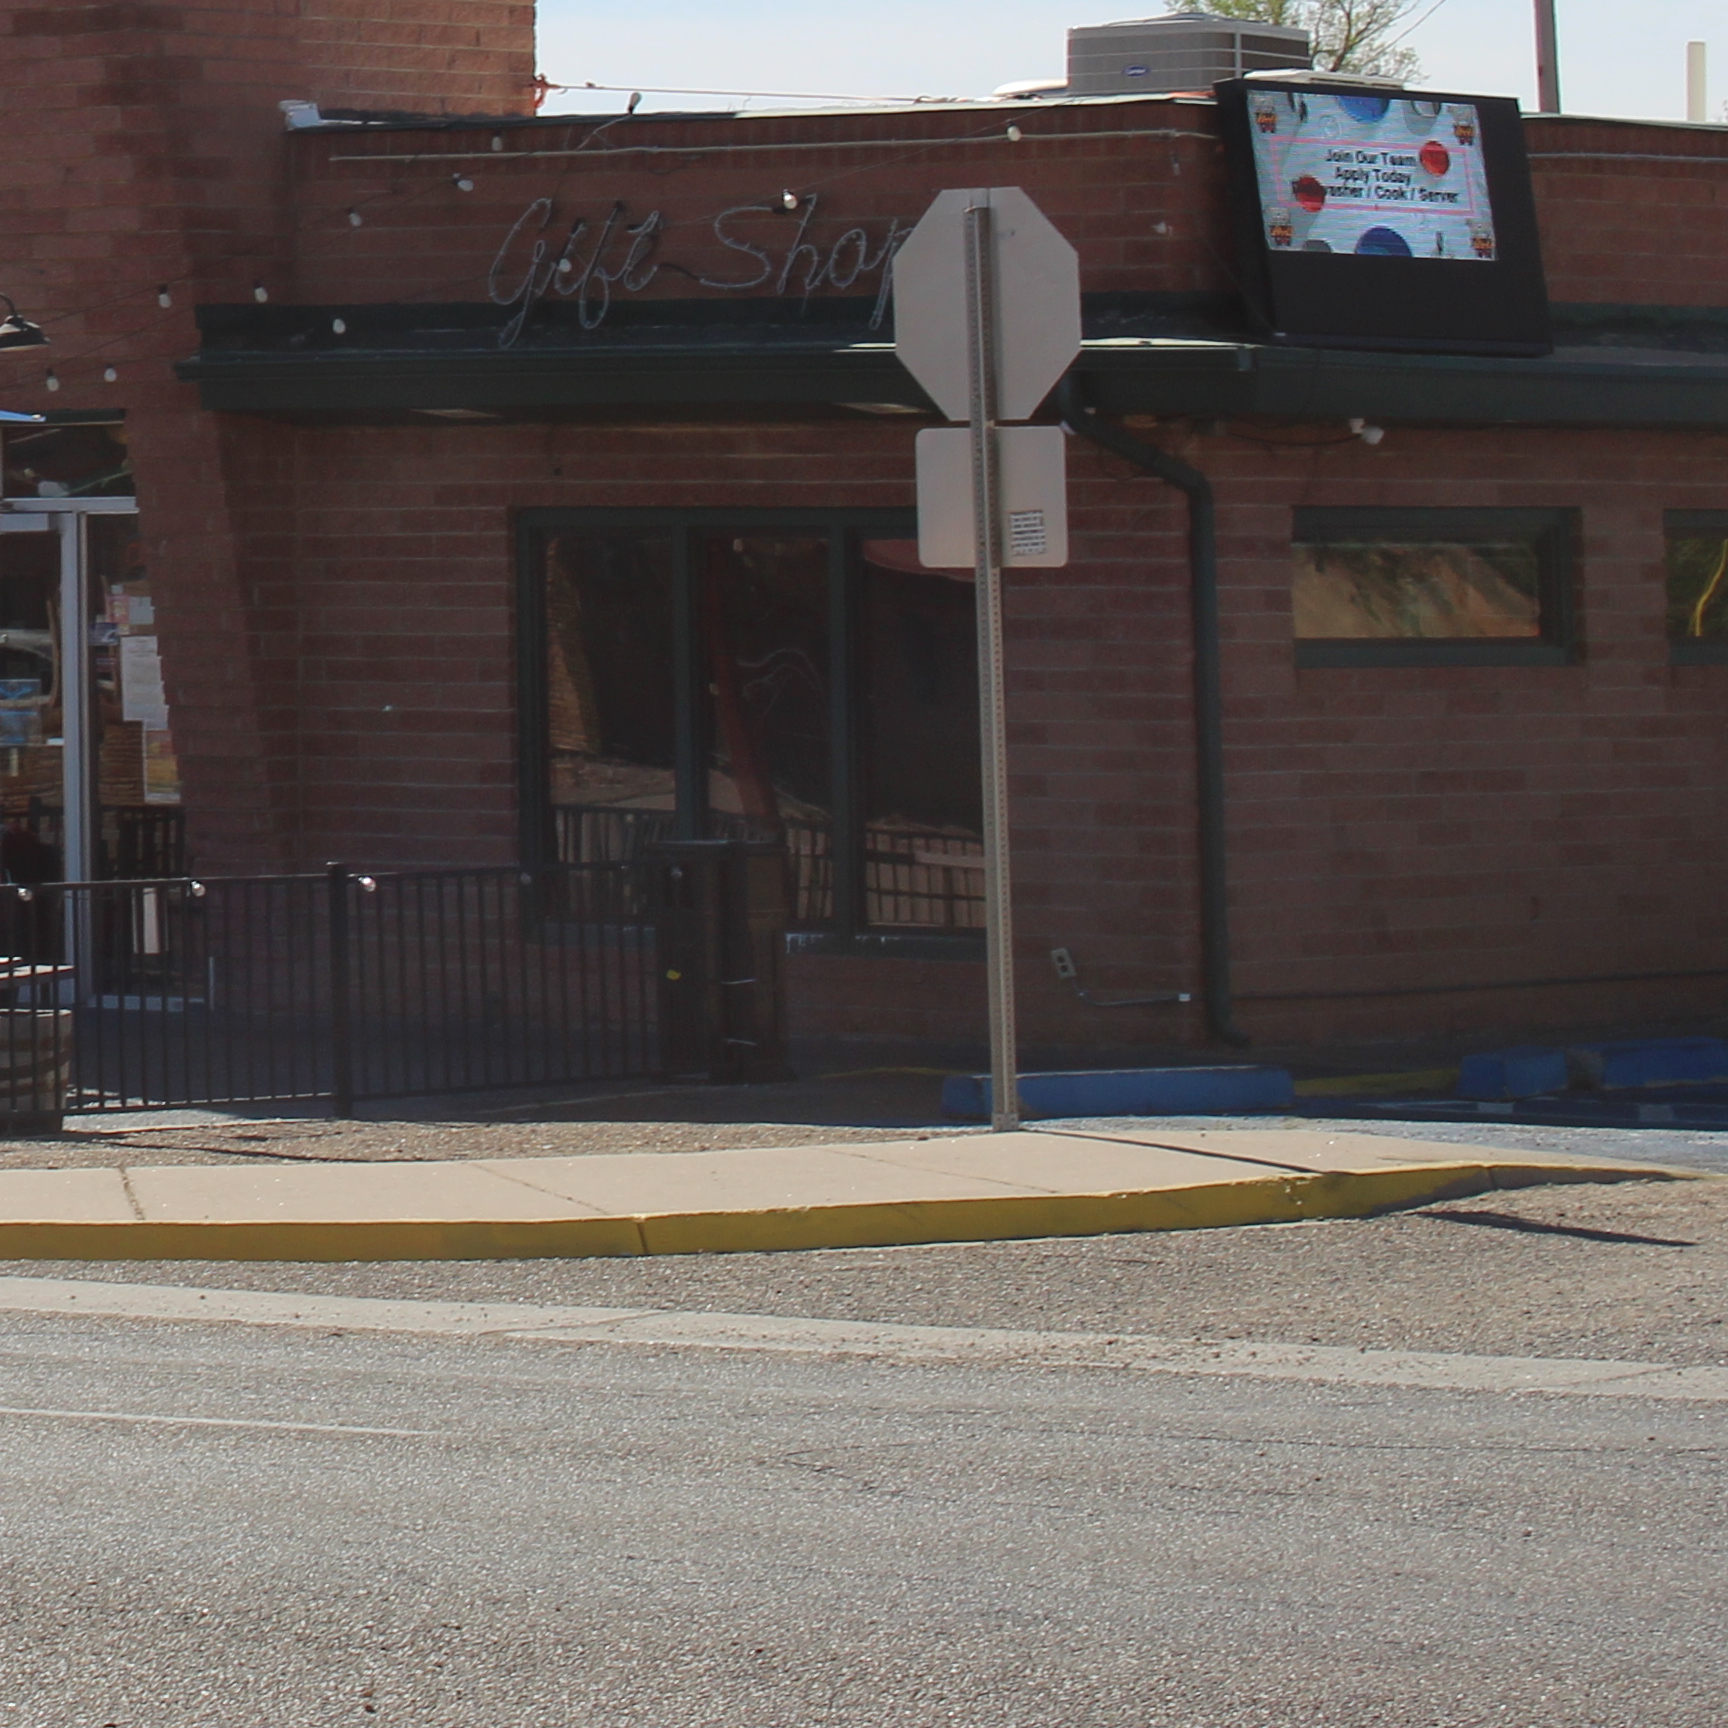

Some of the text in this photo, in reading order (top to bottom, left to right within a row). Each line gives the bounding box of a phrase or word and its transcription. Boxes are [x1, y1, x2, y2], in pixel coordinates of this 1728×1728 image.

[1325, 148, 1417, 167] Join Our Team
[1334, 167, 1412, 186] Apply Today
[1374, 185, 1408, 200] Cook
[1418, 188, 1460, 204] Server
[489, 197, 662, 348] Gift
